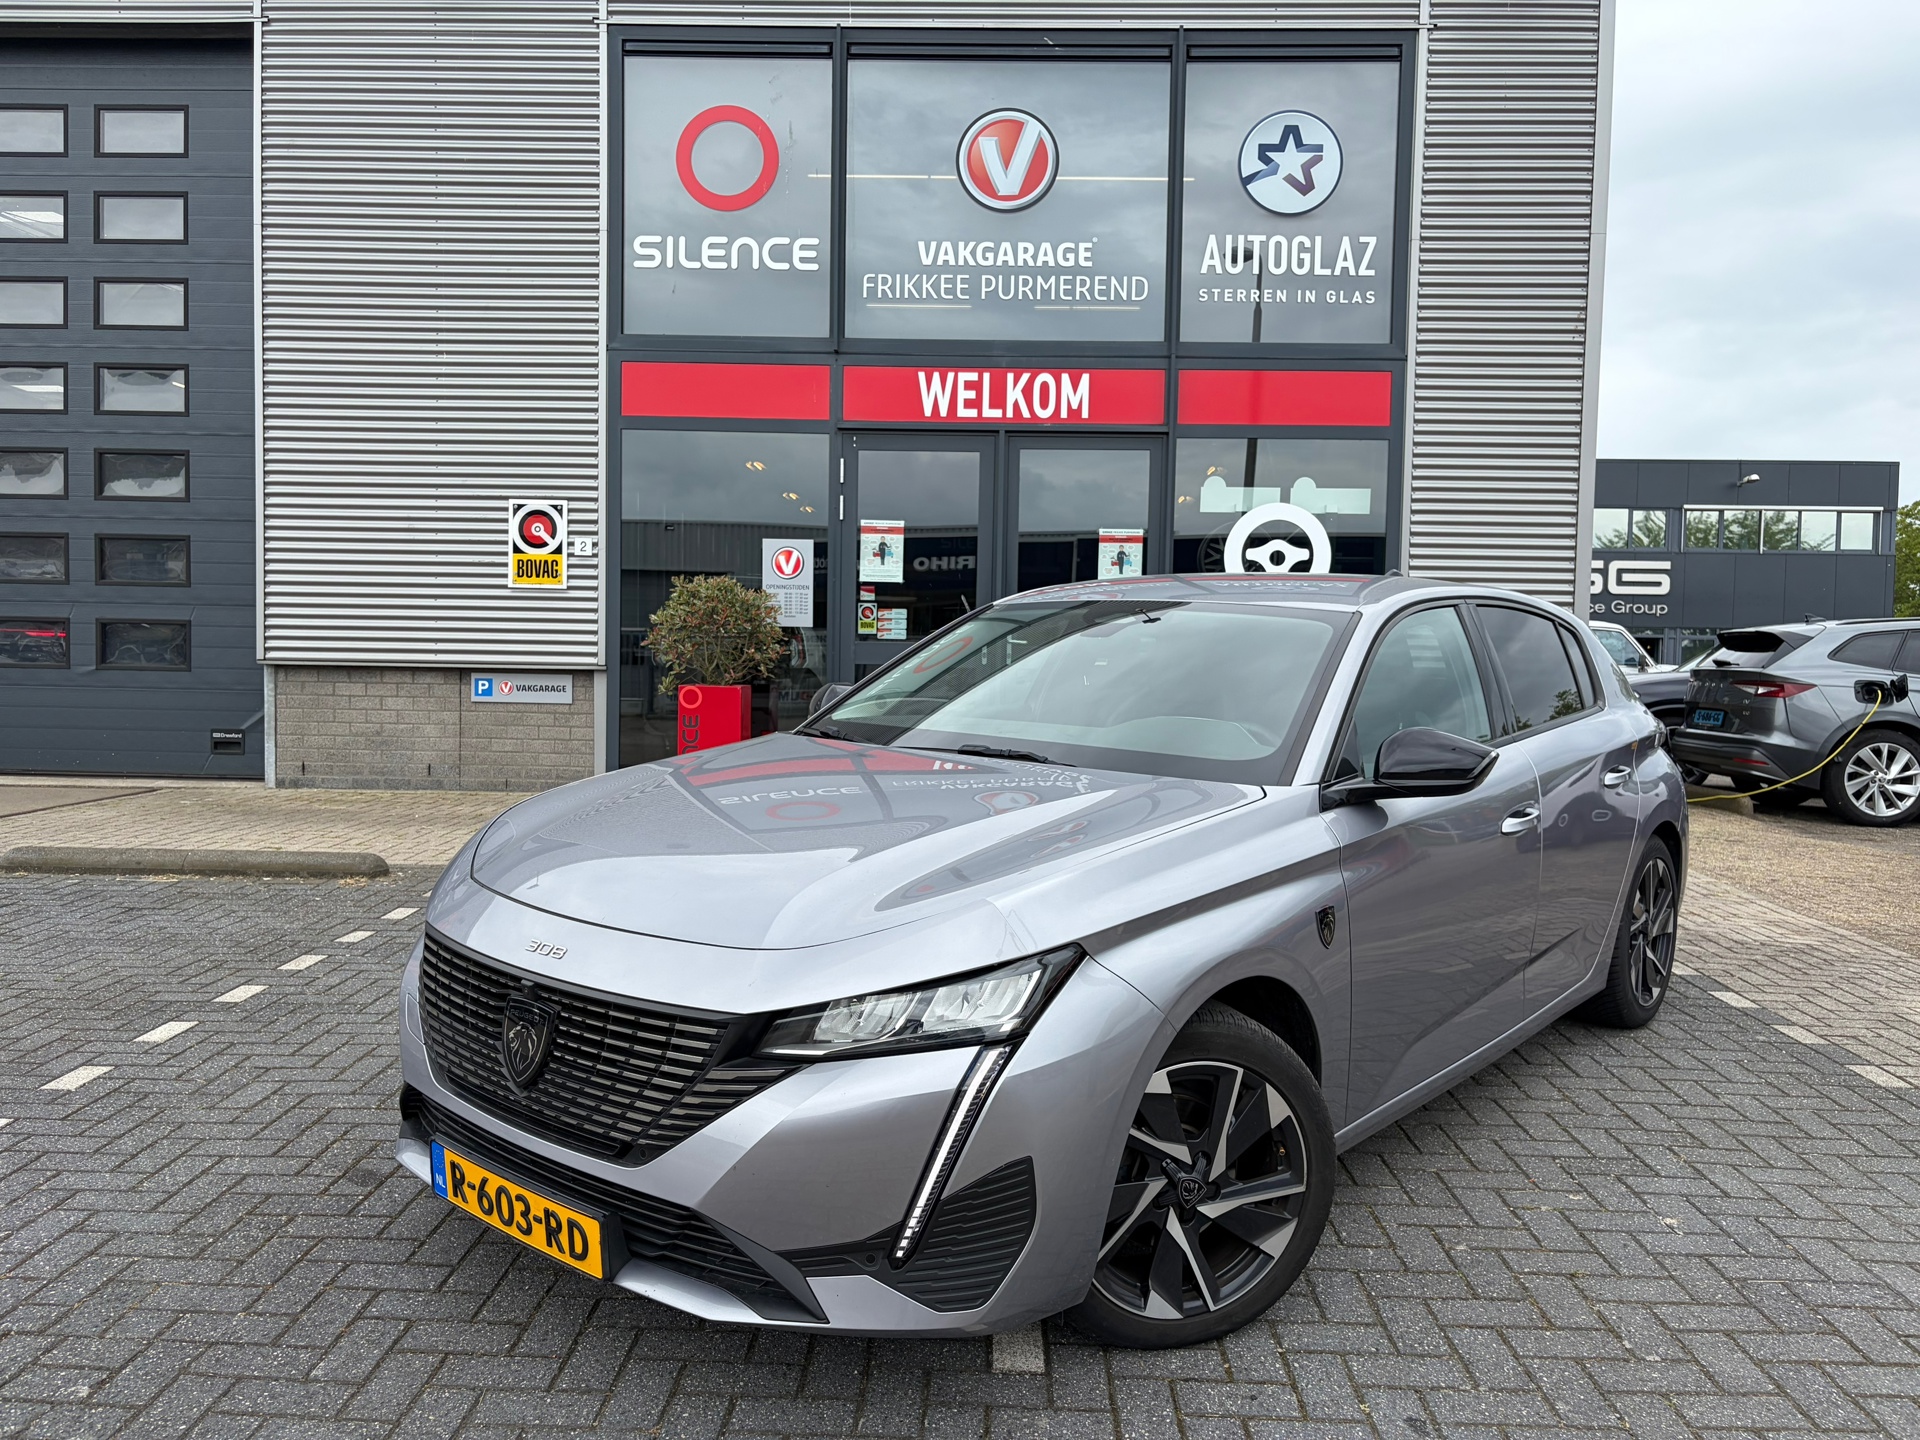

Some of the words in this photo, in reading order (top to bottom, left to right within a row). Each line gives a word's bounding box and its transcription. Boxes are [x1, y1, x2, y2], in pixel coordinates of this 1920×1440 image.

[633, 235, 820, 271] SILENCE
[917, 241, 1093, 267] VAKGARAGE
[1200, 234, 1377, 276] AUTOGLAZ
[862, 273, 970, 299] FRIKKEE
[981, 275, 1149, 301] PURMEREND
[1199, 288, 1287, 303] STERREN
[1297, 290, 1316, 303] IN
[1326, 290, 1376, 304] GLAS
[917, 371, 1090, 419] WELKOM
[580, 541, 587, 552] 2
[516, 558, 559, 579] BOVAG
[1611, 600, 1668, 617] Group
[478, 680, 490, 694] P
[515, 684, 567, 693] VAKGARAGE
[525, 938, 568, 960] 308
[510, 1008, 545, 1026] PEUGEOT
[436, 1172, 446, 1188] NL
[450, 1159, 589, 1262] R-603-RD
